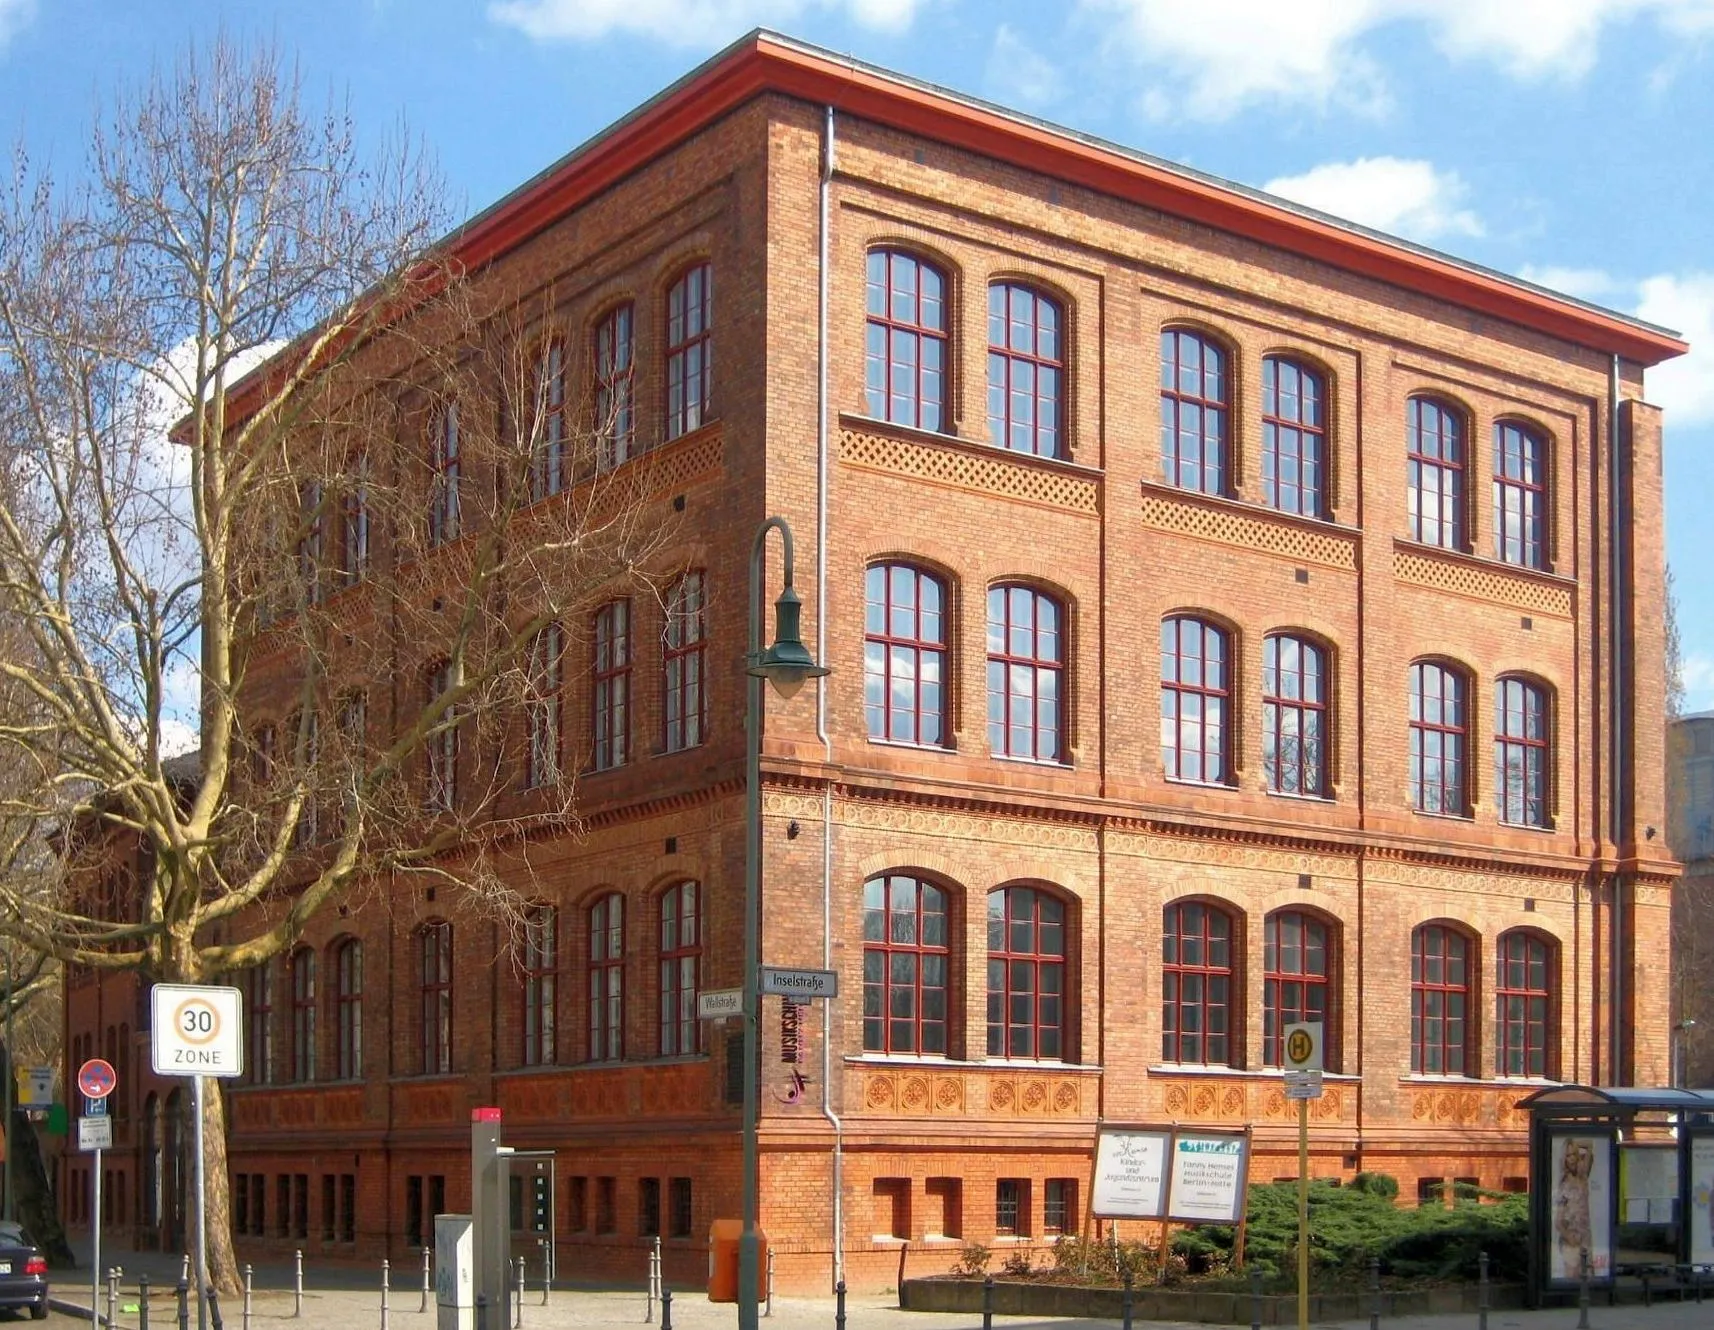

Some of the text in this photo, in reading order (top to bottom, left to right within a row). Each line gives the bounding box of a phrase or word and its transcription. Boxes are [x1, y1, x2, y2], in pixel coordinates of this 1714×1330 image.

[773, 973, 824, 990] Inselstraße
[705, 995, 737, 1010] Wallstraße
[184, 1010, 211, 1032] 30
[1292, 1036, 1305, 1056] H
[174, 1049, 222, 1064] ZONE
